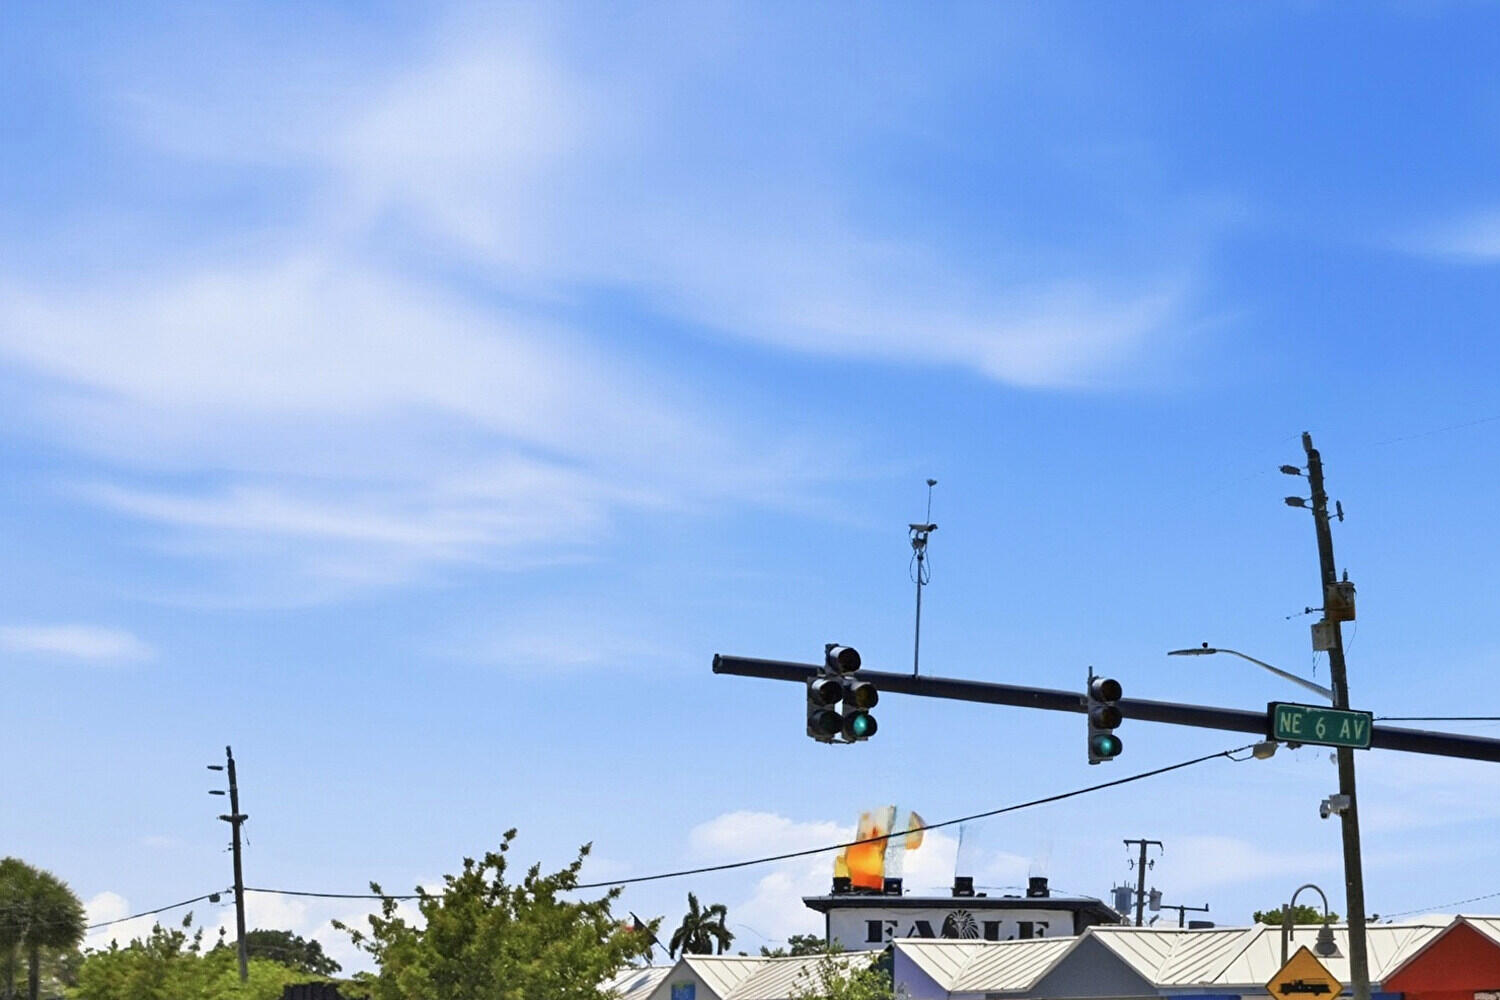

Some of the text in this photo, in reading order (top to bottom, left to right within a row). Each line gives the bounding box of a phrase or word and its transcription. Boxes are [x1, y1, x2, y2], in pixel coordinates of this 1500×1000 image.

[1280, 711, 1366, 740] NE 6 AV
